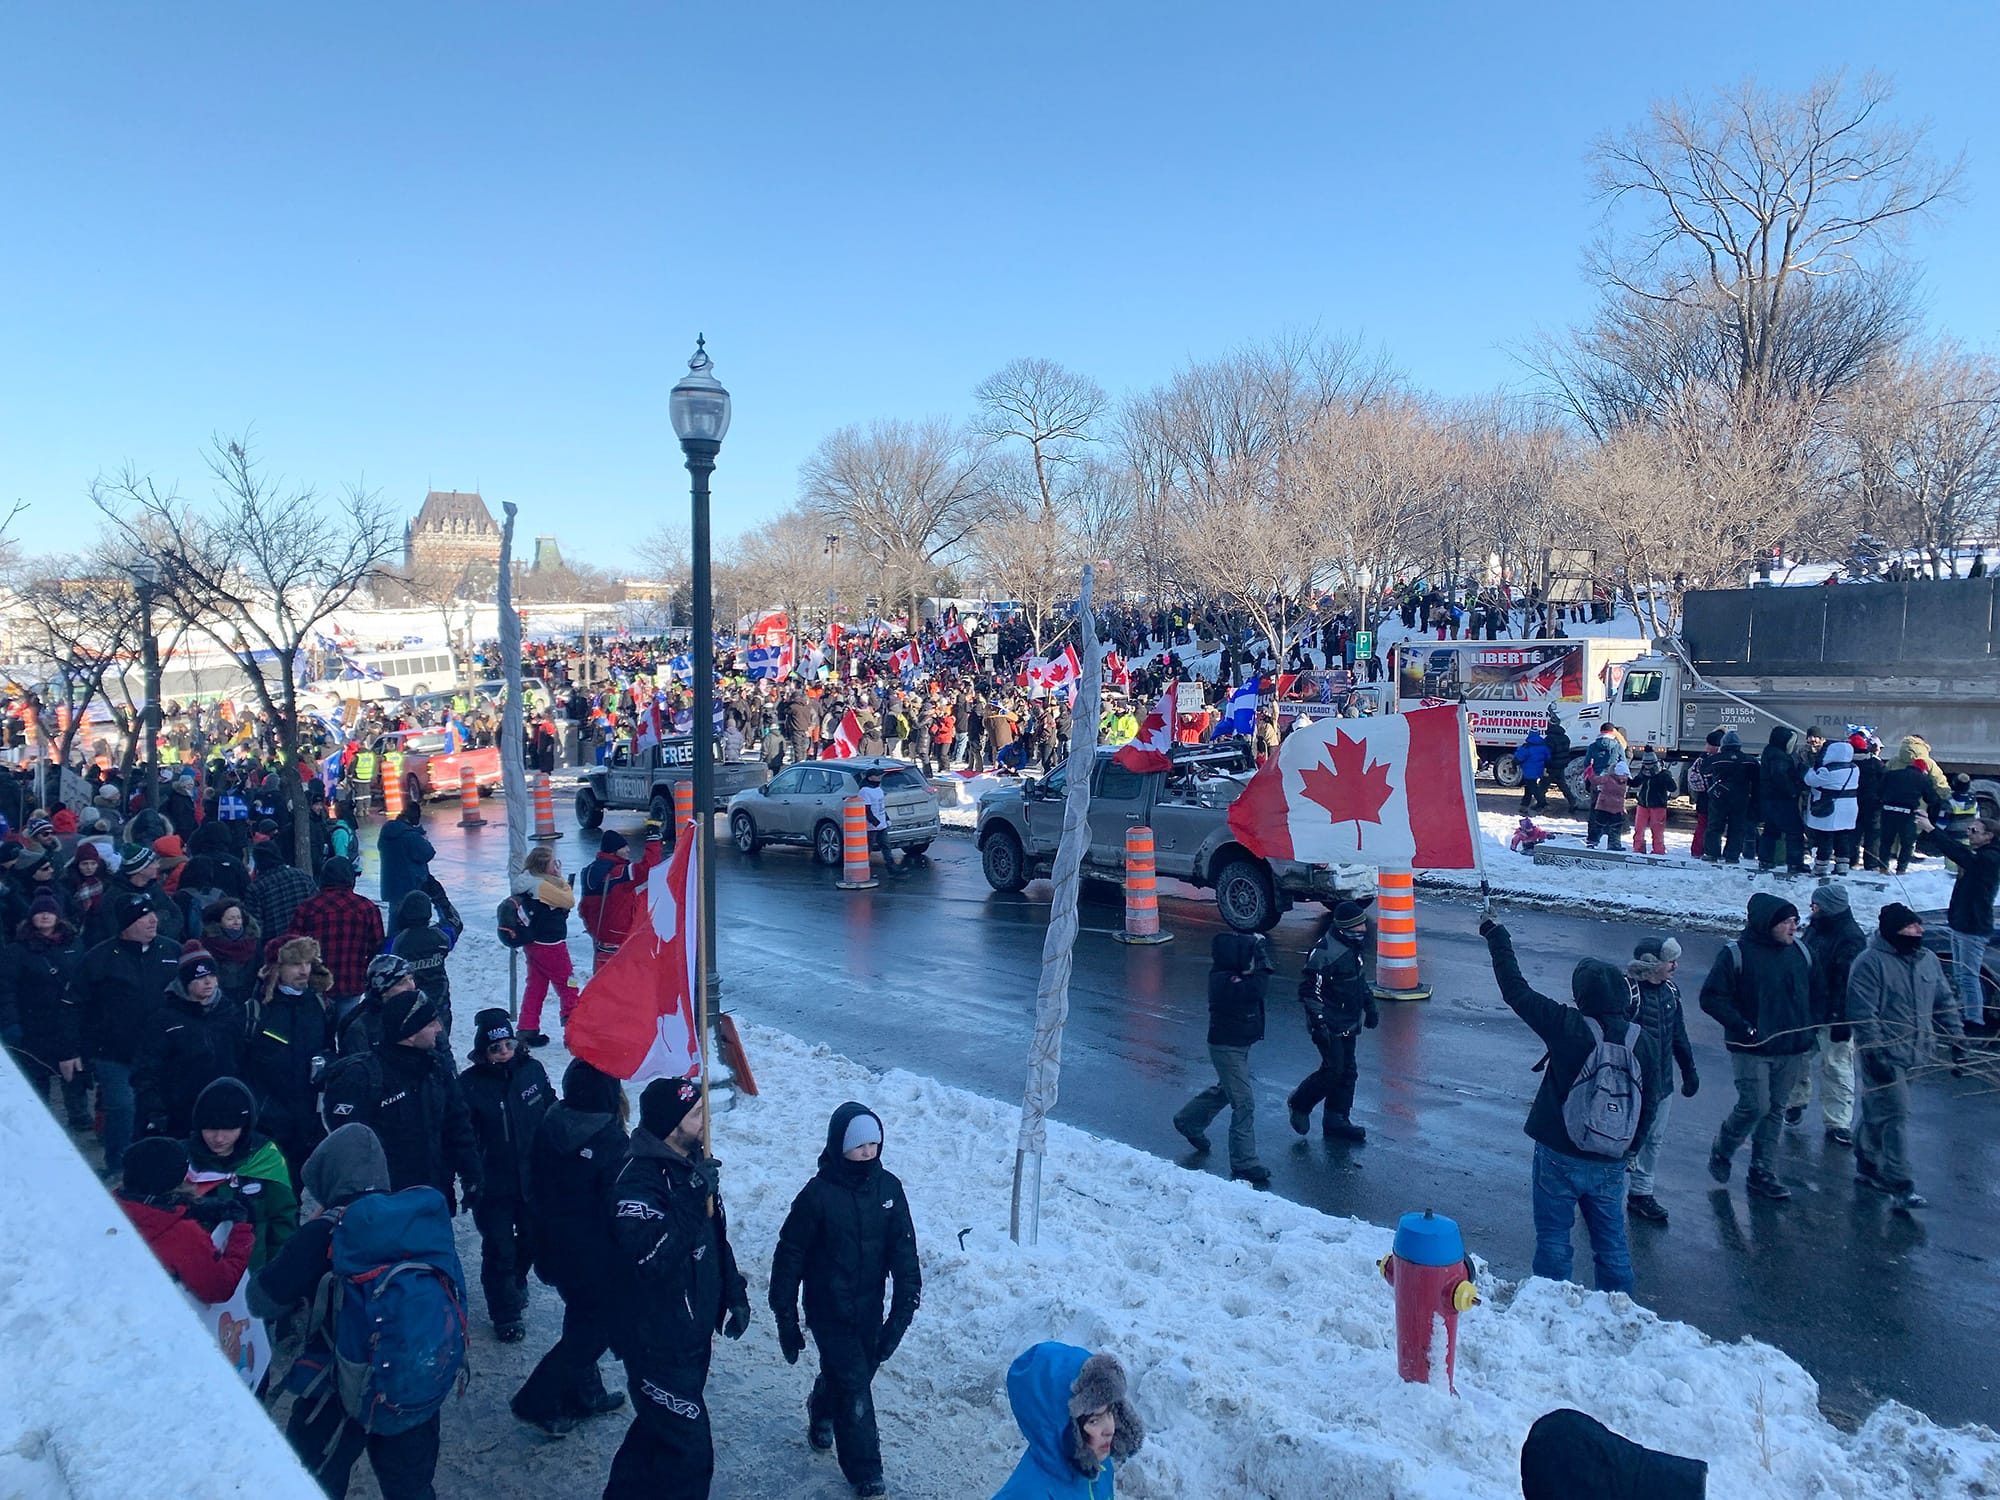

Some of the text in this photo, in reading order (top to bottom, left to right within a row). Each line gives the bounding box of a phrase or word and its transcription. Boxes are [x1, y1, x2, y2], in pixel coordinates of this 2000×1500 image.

[1360, 634, 1368, 649] P
[1470, 650, 1542, 664] LIBERTÉ
[1307, 706, 1331, 714] LEGAULT
[1482, 709, 1544, 718] SUPPORTONS
[1467, 712, 1548, 728] CAMIONNEU
[662, 745, 694, 764] FREE
[614, 778, 649, 800] FREEDOM
[640, 1379, 700, 1420] FXR
